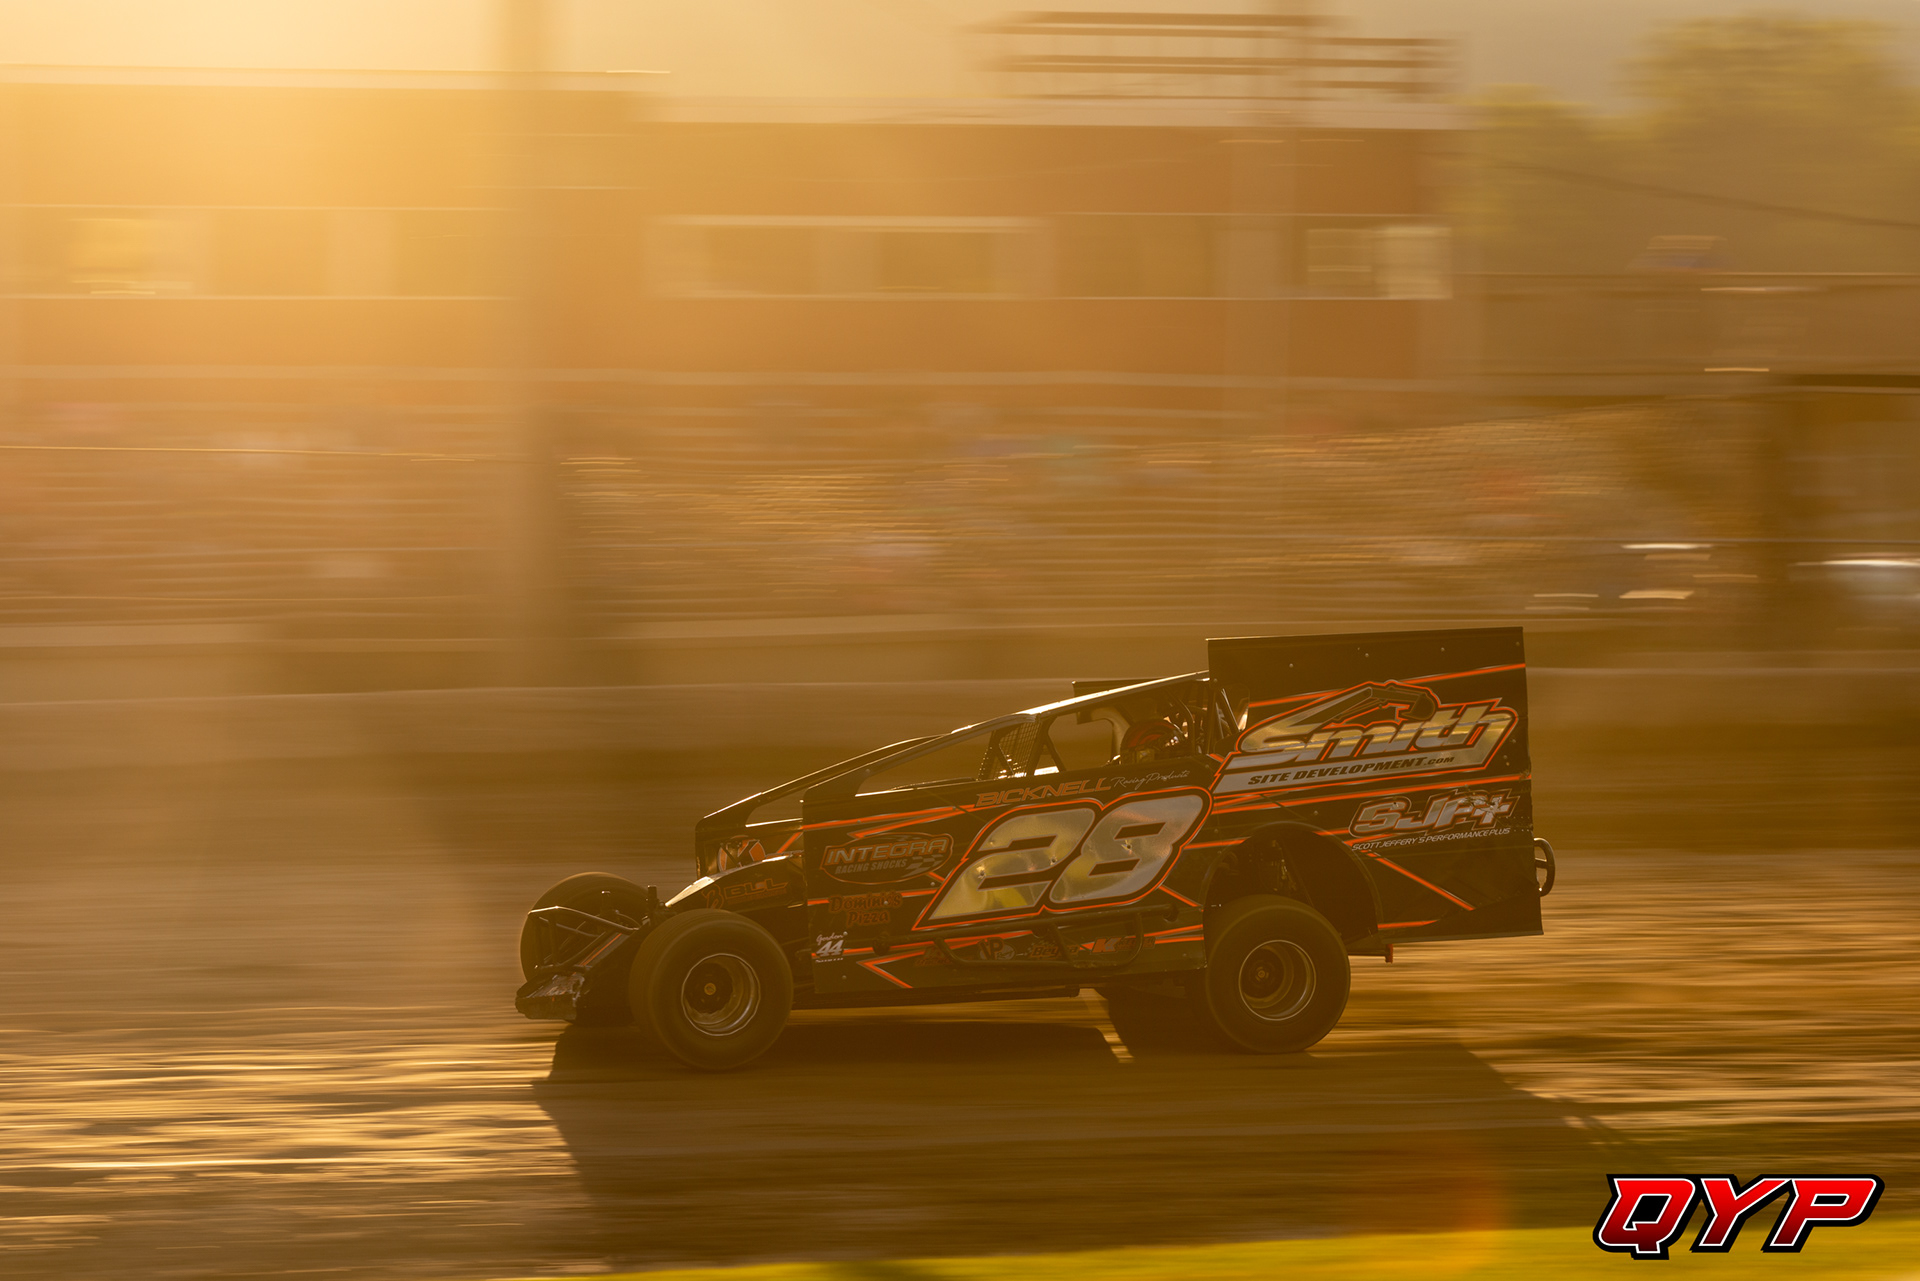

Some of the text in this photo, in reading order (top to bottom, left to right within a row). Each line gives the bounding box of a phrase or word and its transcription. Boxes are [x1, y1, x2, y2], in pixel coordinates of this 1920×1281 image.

[1226, 687, 1515, 770] Smith
[976, 770, 1191, 806] BICKNELL Racing Products
[1248, 771, 1289, 786] SITE
[1352, 827, 1511, 851] SCOTT JEFFERY'S PERFORMANCE PLUS
[826, 838, 949, 865] INTEGRA
[926, 793, 1207, 921] 28
[835, 858, 908, 875] RACING SHOCKS
[848, 911, 889, 927] Pizza
[816, 939, 844, 957] 44
